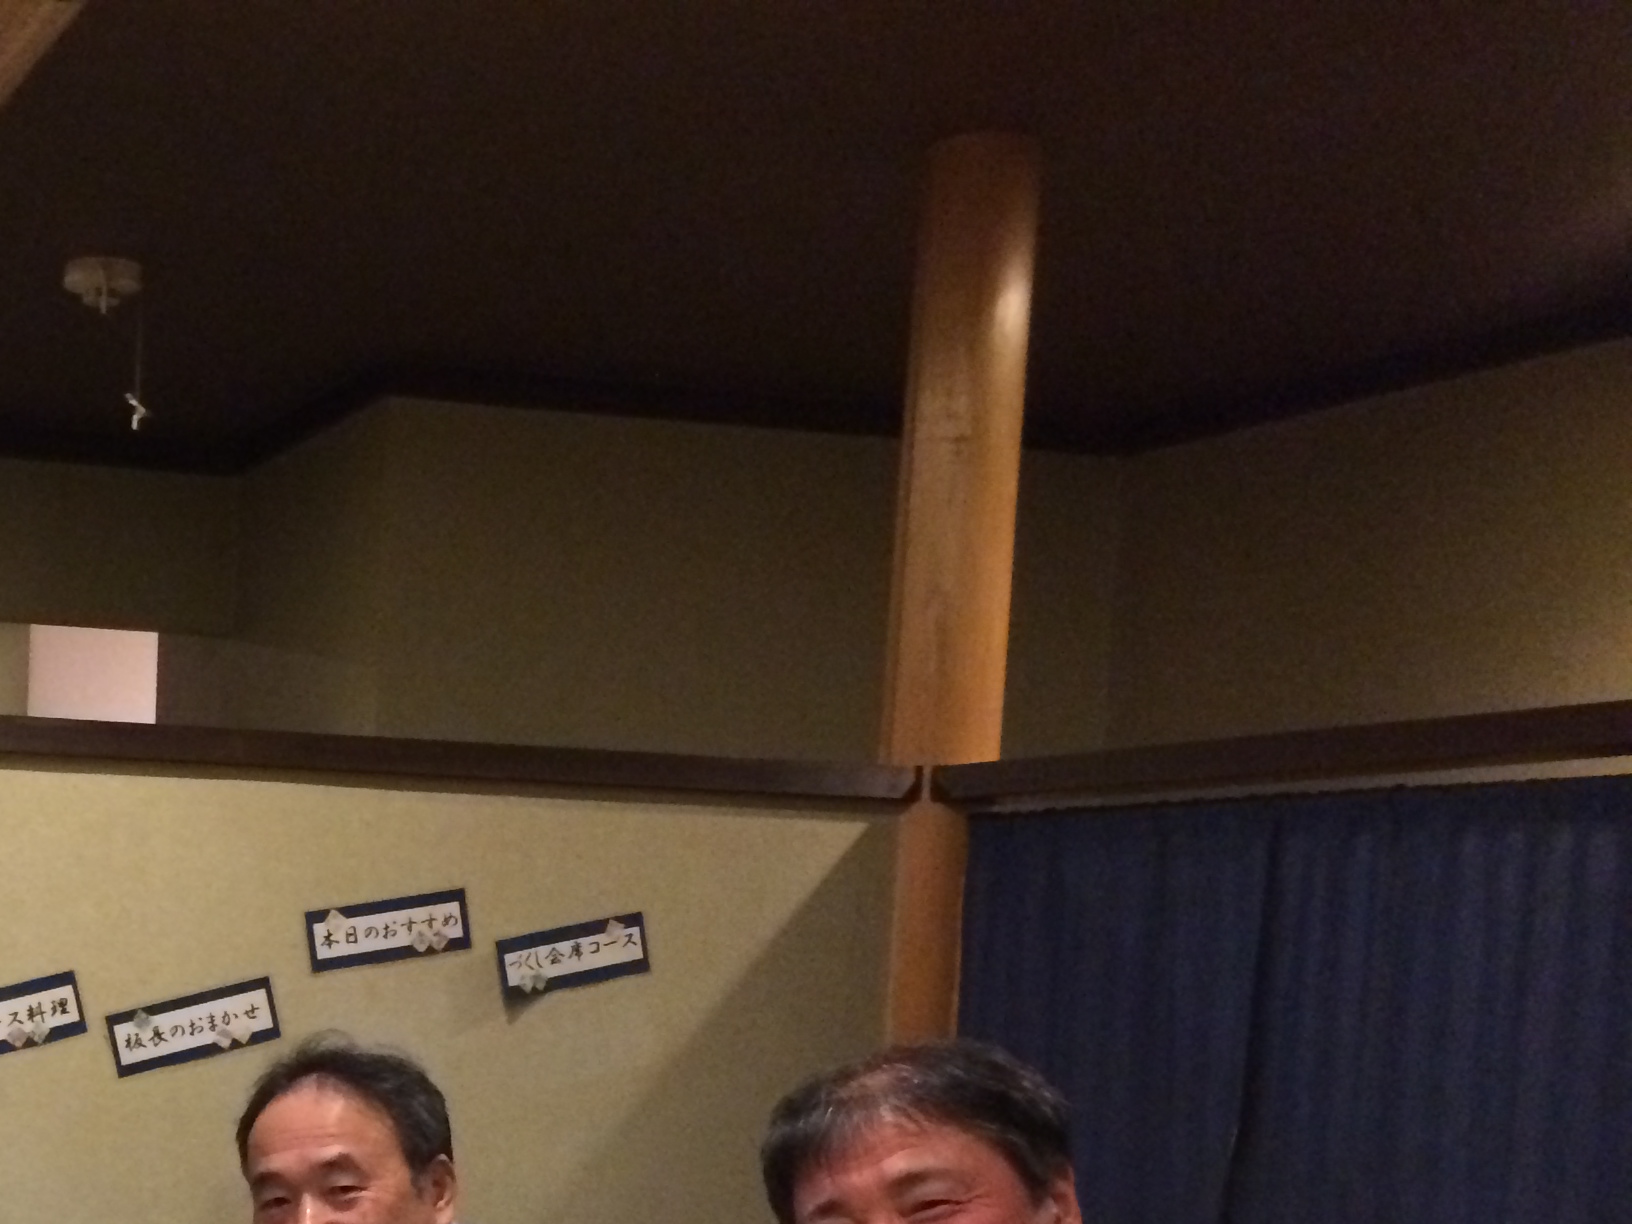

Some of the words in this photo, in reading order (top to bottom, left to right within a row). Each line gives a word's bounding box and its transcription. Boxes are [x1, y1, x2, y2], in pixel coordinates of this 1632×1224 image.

[320, 912, 458, 949] 本日のおすすめ
[125, 1003, 260, 1051] 板長のおまかせ
